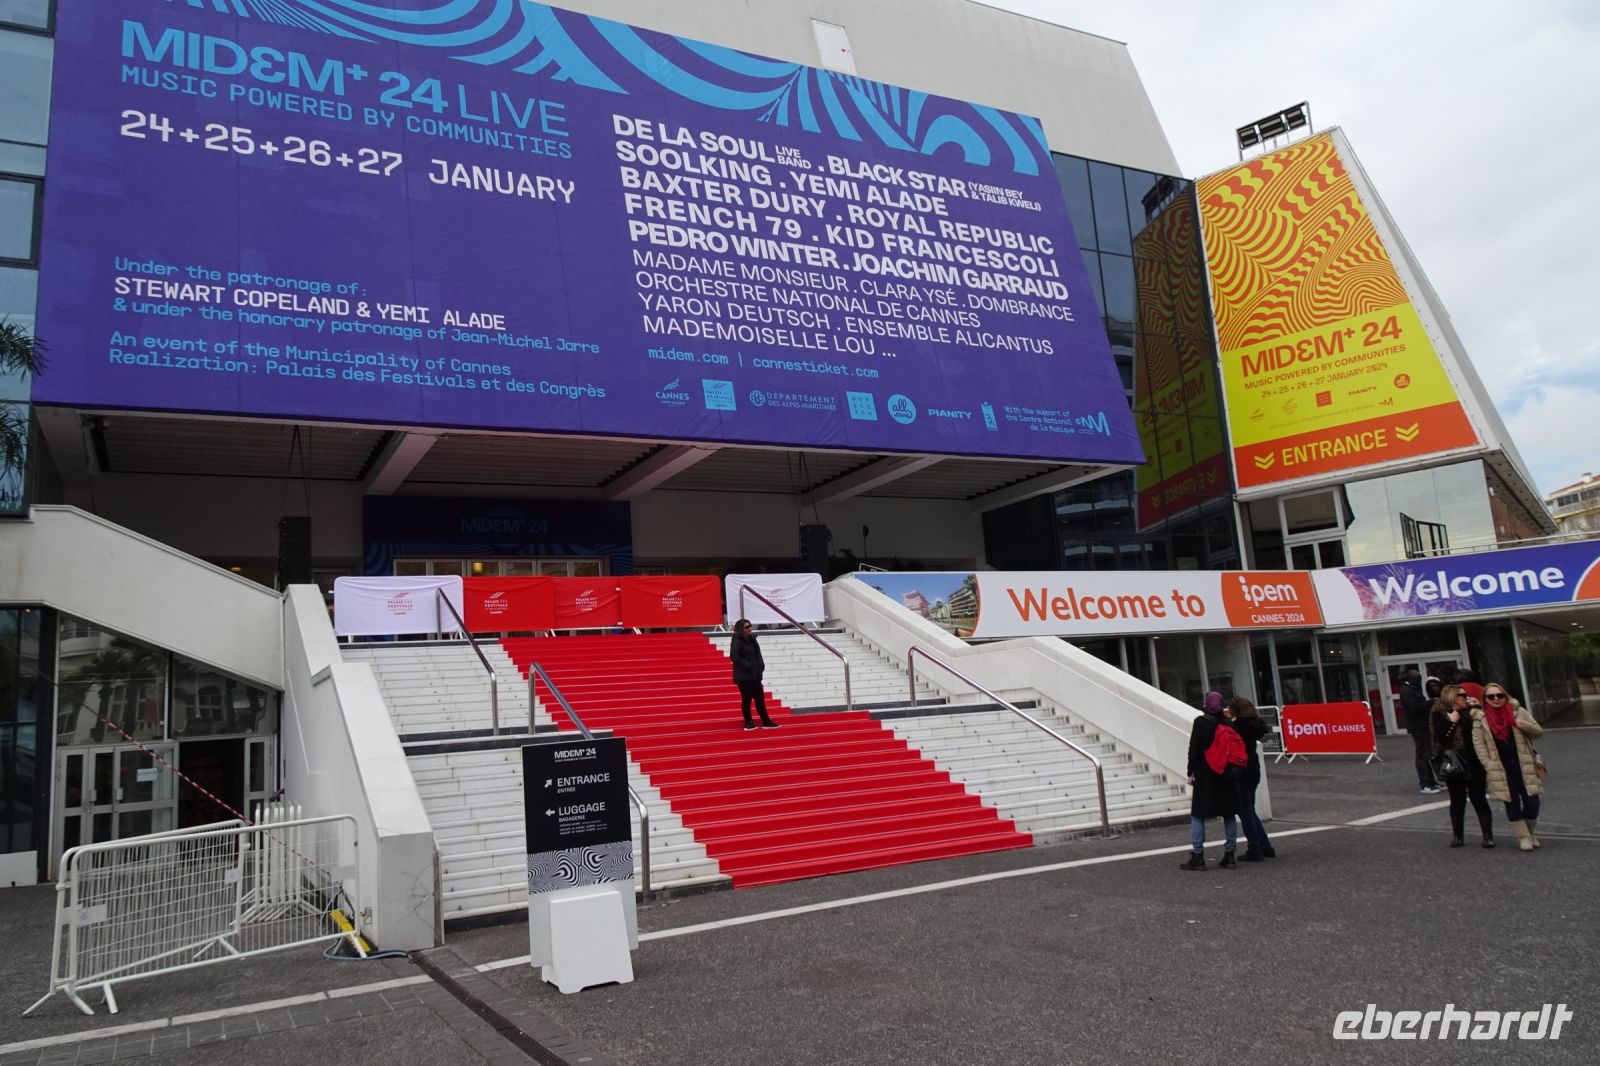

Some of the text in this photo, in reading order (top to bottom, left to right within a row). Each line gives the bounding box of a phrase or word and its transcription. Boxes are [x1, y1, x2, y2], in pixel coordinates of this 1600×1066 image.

[122, 64, 572, 158] MUSIC POWERED BY COMMUNITIES
[379, 71, 448, 113] 24
[458, 84, 569, 136] LIVE
[613, 114, 775, 163] DE LA SOUL
[775, 145, 801, 159] LIVE
[616, 140, 948, 216] SOOLKING YEMI ALADE
[777, 155, 812, 169] BAND
[827, 155, 969, 198] BLACK STAR
[429, 159, 574, 203] JANUARY
[971, 191, 980, 200] &
[980, 193, 1008, 205] TALIB
[1004, 189, 1023, 200] BEY
[620, 166, 1054, 254] BAXTER DURY ROYAL REPUBLIC
[624, 192, 1059, 278] FRENCH 79 KID FRANCESCOLI
[116, 257, 178, 276] Under
[186, 266, 221, 280] the
[228, 272, 331, 294] patronage
[628, 220, 1069, 300] PEDRO WINTER JOACHIM GARRAUD
[115, 277, 506, 330] STEWART COPELAND & YEMI ALADE
[633, 249, 1074, 321] MADAME MONSIEUR CLARA YSÉ DOMBRANCE
[636, 271, 980, 328] ORCHESTRE NATIONAL DE CANNES
[114, 297, 599, 353] & under the honorary patronage of Jean-Michel Jarre
[638, 292, 1053, 354] YARON DEUTSCH ENSEMBLE ALICANTUS
[643, 315, 828, 350] MADEMOISELLE
[834, 335, 874, 354] LOU
[1361, 315, 1402, 347] 24
[111, 331, 511, 375] An event of the Municipality of Cannes
[648, 347, 728, 364] midem.com
[753, 358, 878, 378] cannesticket.com
[1244, 344, 1407, 390] MUSIC POWERED BY COMMUNITIES
[110, 349, 605, 399] Realization: Palais des Festivals et des Congrès
[1261, 361, 1388, 398] 24 25 26 27 JANUARY 2024
[655, 391, 690, 401] CANNES
[927, 408, 972, 419] PIANITY
[1282, 428, 1388, 466] ENTRANCE
[528, 519, 548, 533] 24
[1006, 587, 1206, 622] Welcome to
[1238, 575, 1299, 607] ipem
[1368, 567, 1566, 605] Welcome
[1251, 612, 1306, 623] CANNES 2024
[1287, 718, 1366, 739] ipem CANNES
[586, 748, 596, 756] 24
[557, 772, 610, 787] ENTRANCE
[557, 786, 576, 794] ENTRÉE
[558, 802, 606, 816] LUGGAGE
[558, 814, 586, 823] BAGAGERIE
